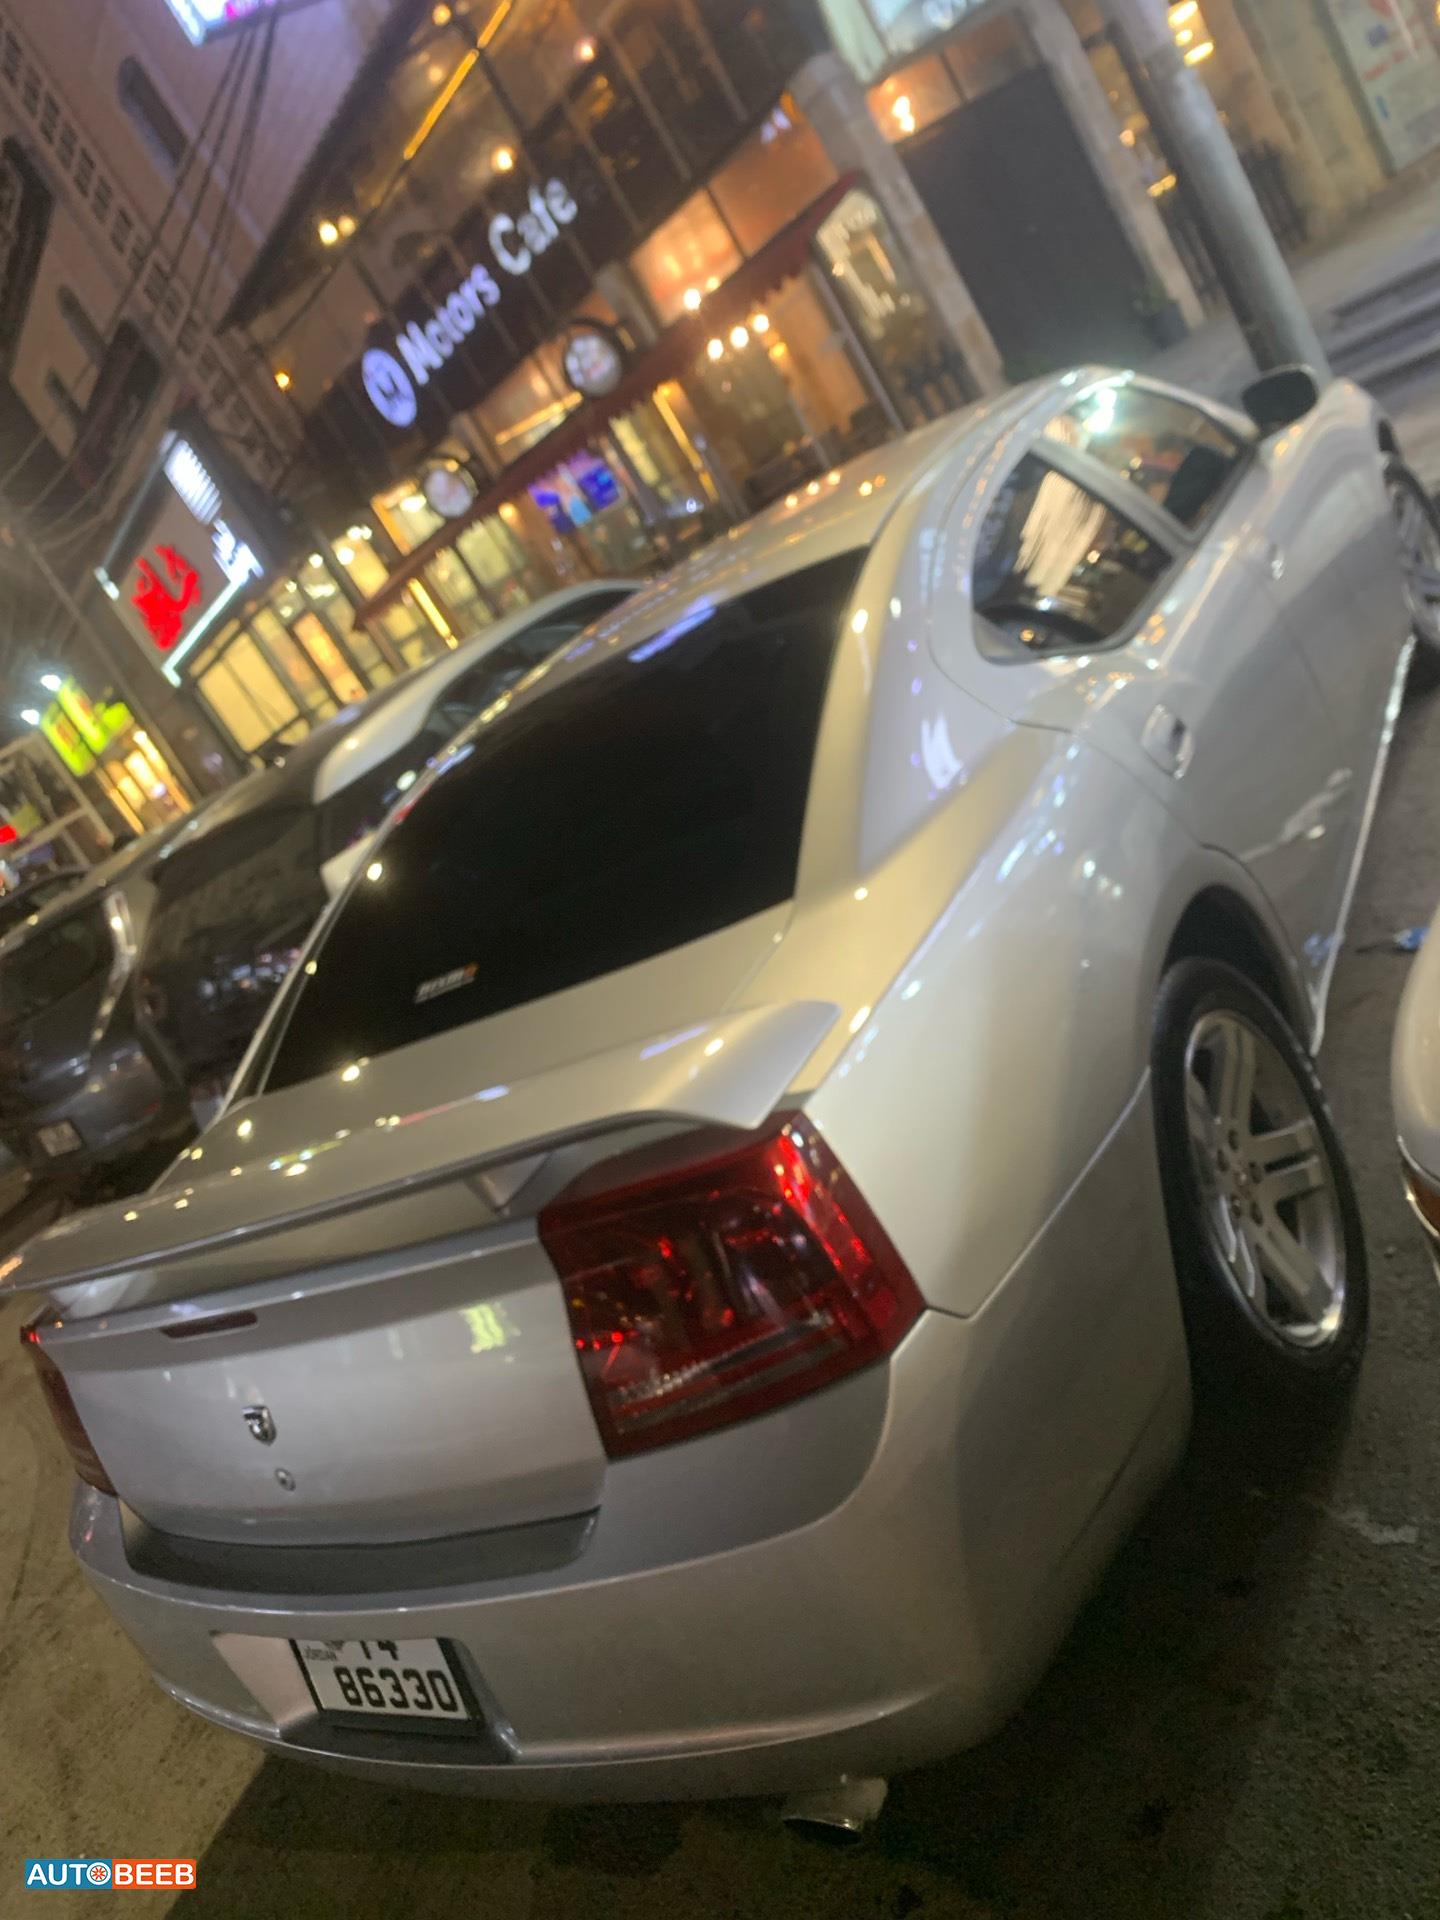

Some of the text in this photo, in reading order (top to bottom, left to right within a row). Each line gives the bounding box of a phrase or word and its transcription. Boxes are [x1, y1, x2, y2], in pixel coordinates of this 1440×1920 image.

[396, 177, 578, 385] Motors Cafe
[333, 1666, 458, 1712] 86330
